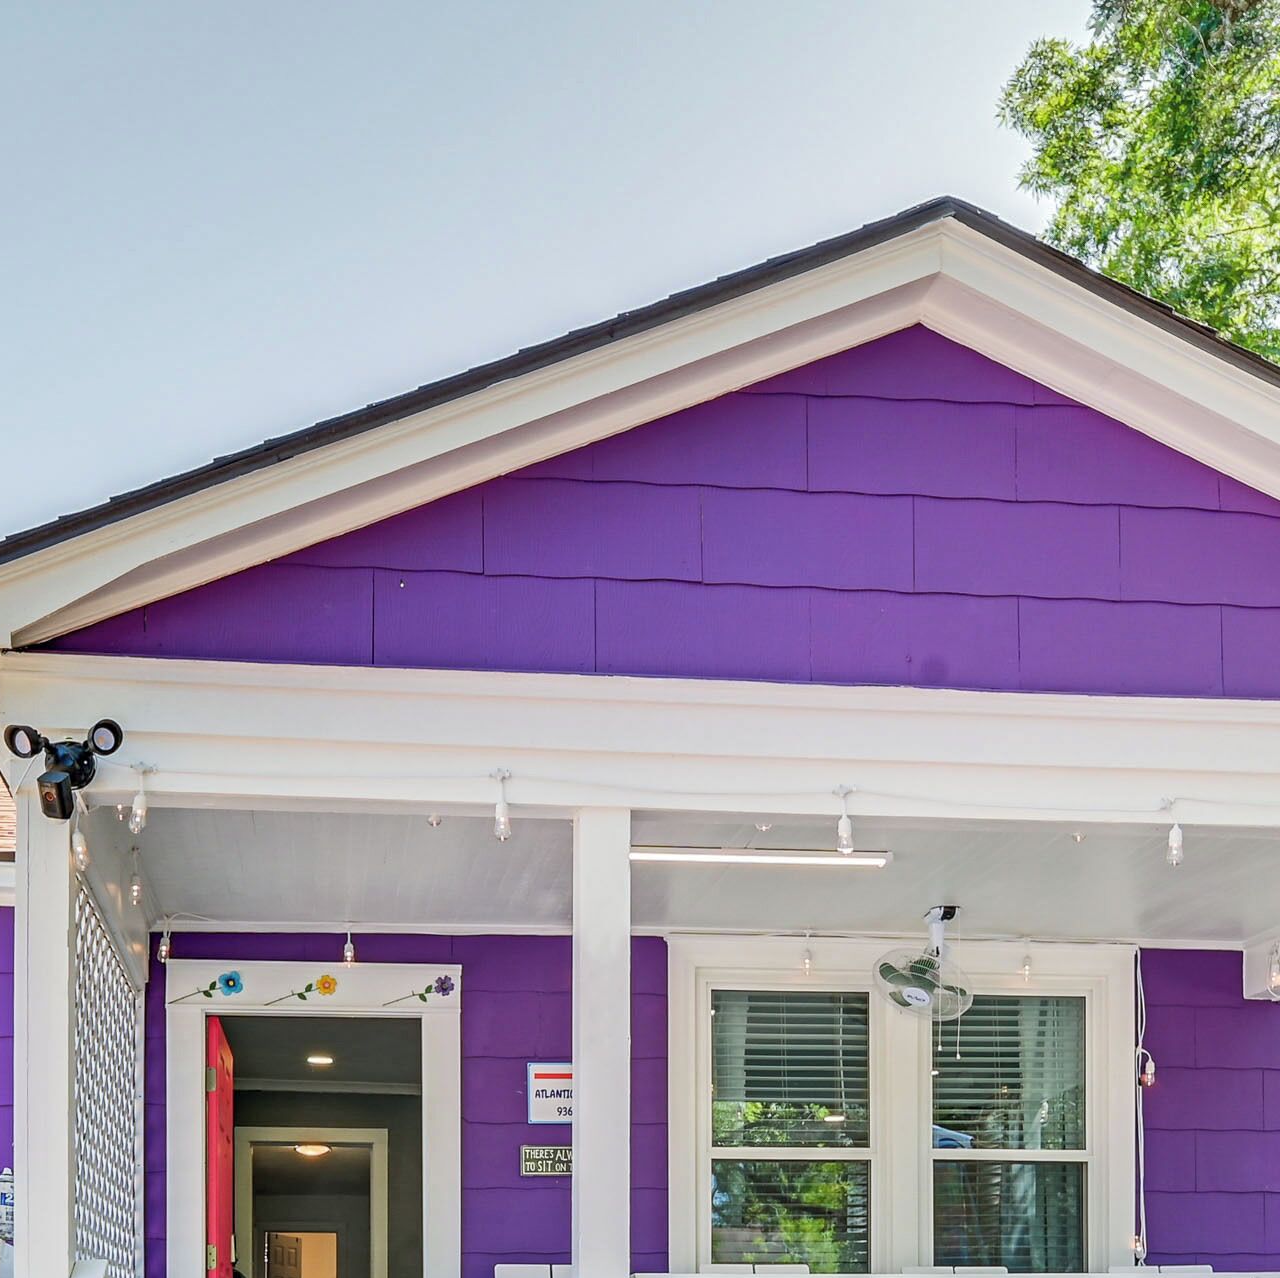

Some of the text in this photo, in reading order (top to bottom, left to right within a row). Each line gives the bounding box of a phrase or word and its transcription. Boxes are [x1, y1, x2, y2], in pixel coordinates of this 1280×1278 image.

[525, 1162, 536, 1172] TO
[537, 1160, 553, 1172] SIT
[555, 1162, 567, 1172] ON
